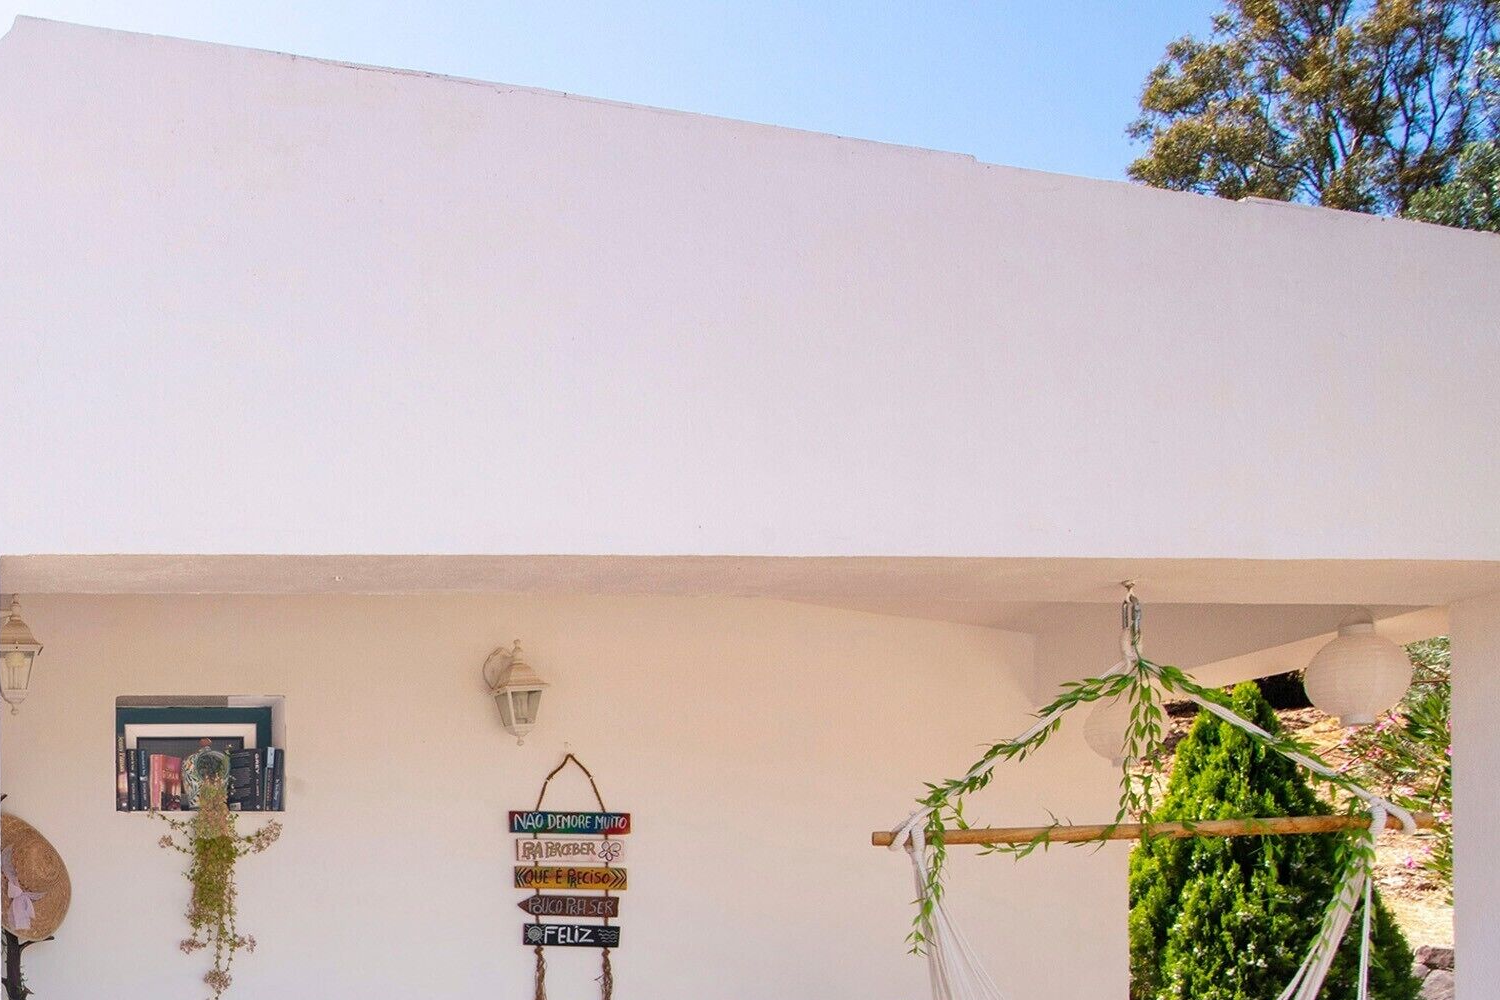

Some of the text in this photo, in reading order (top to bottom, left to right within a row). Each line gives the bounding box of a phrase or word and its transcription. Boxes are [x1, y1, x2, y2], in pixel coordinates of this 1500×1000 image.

[514, 812, 628, 831] NÃO DEMORE MUITO
[521, 841, 597, 859] PRA PERCEBER
[523, 868, 548, 886] QUE
[528, 896, 614, 915] POUCO PRA SER
